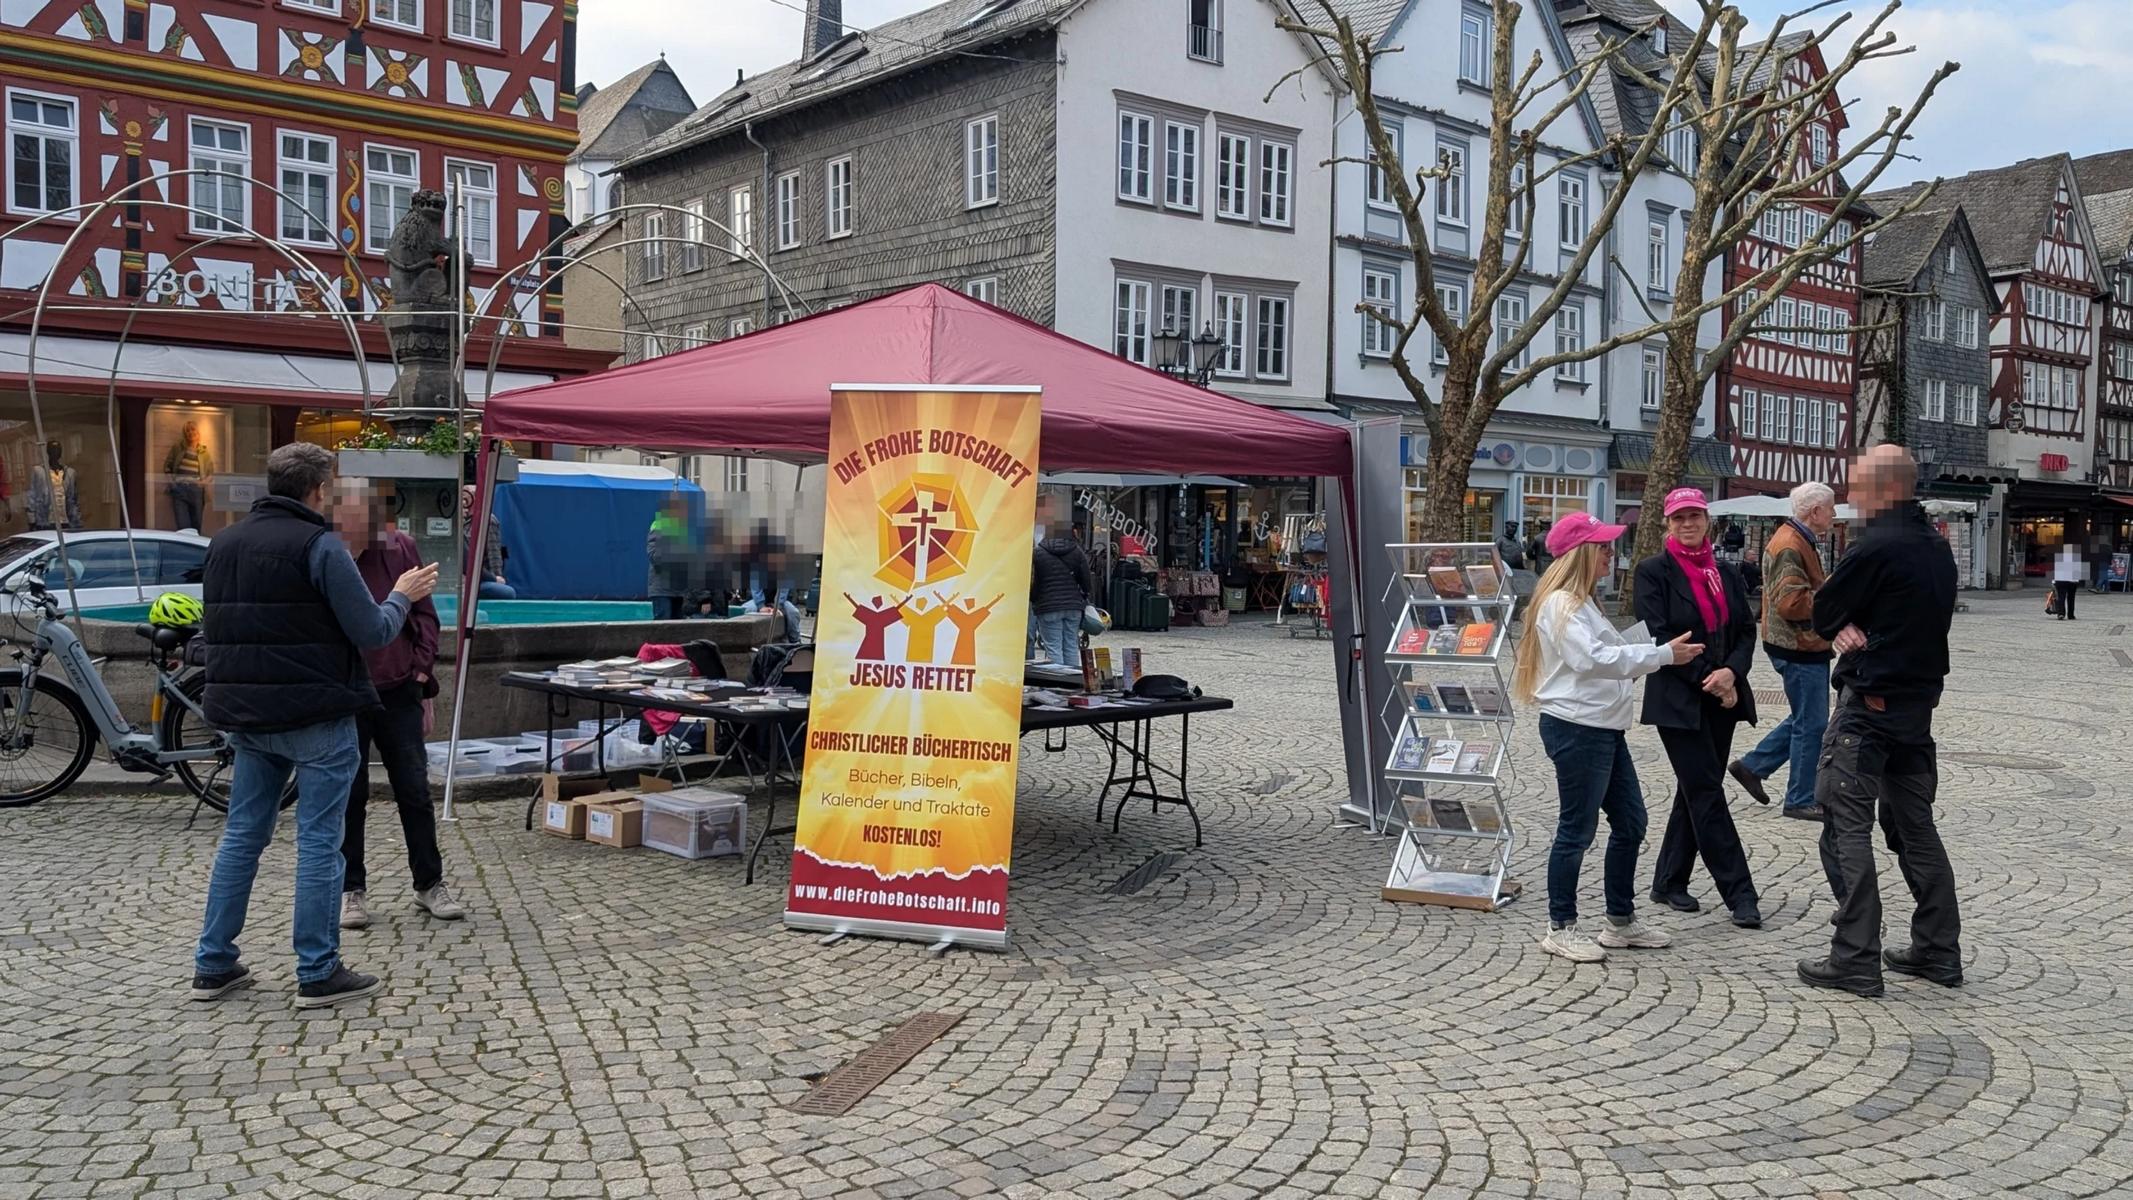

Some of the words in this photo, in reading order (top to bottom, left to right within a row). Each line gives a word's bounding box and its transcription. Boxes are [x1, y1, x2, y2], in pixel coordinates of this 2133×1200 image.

[156, 267, 303, 308] BONITA
[833, 451, 867, 485] DIE
[864, 430, 923, 467] FROHE
[928, 429, 1032, 489] BOTSCHAFT
[849, 662, 907, 689] JESUS
[912, 665, 976, 693] RETTET
[810, 730, 909, 755] CHRISTLICHER
[912, 733, 1012, 763] BÜCHERTISCH
[849, 768, 907, 788] Bücher,
[911, 772, 962, 792] Bibeln,
[821, 792, 890, 810] Kalender
[893, 800, 922, 813] und
[926, 800, 991, 818] Traktate
[863, 824, 942, 848] KOSTENLOS!
[795, 884, 1000, 916] www.dieFroheBotschaft.info
